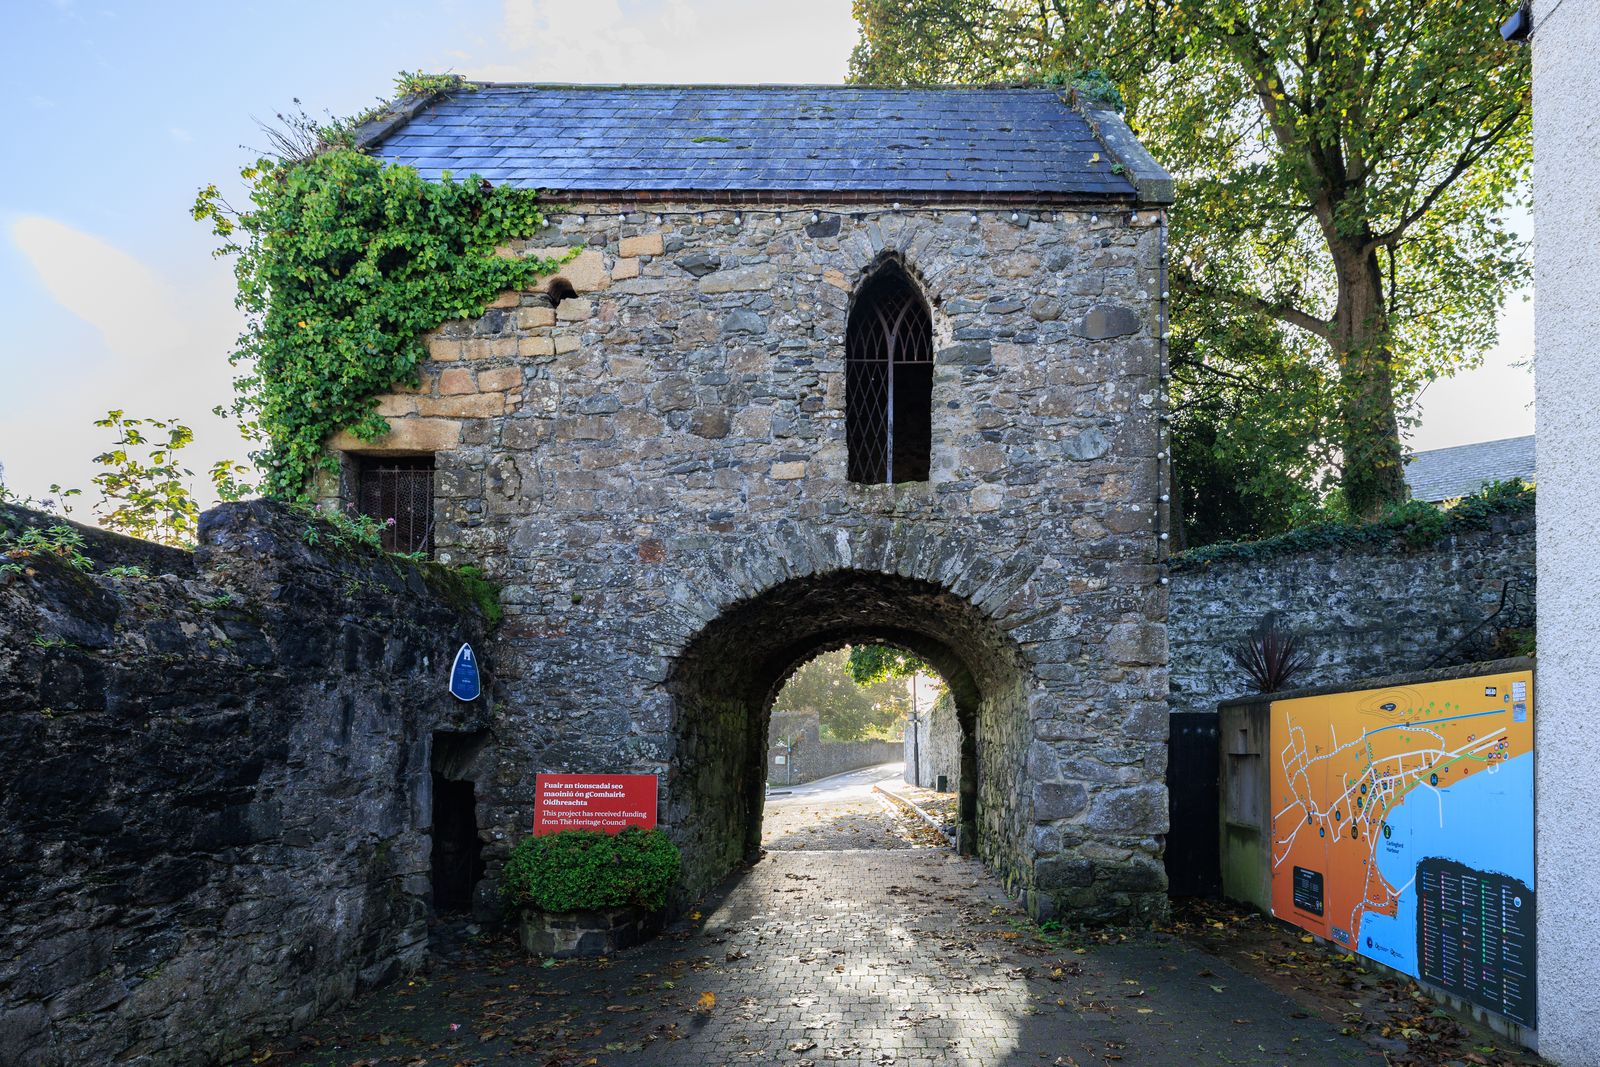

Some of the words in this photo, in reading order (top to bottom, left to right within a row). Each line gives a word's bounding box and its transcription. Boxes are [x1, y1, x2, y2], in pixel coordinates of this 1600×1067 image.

[585, 791, 626, 799] gComhairle
[557, 810, 581, 819] project
[594, 810, 621, 818] received
[621, 810, 647, 820] funding
[573, 819, 601, 827] Heritage
